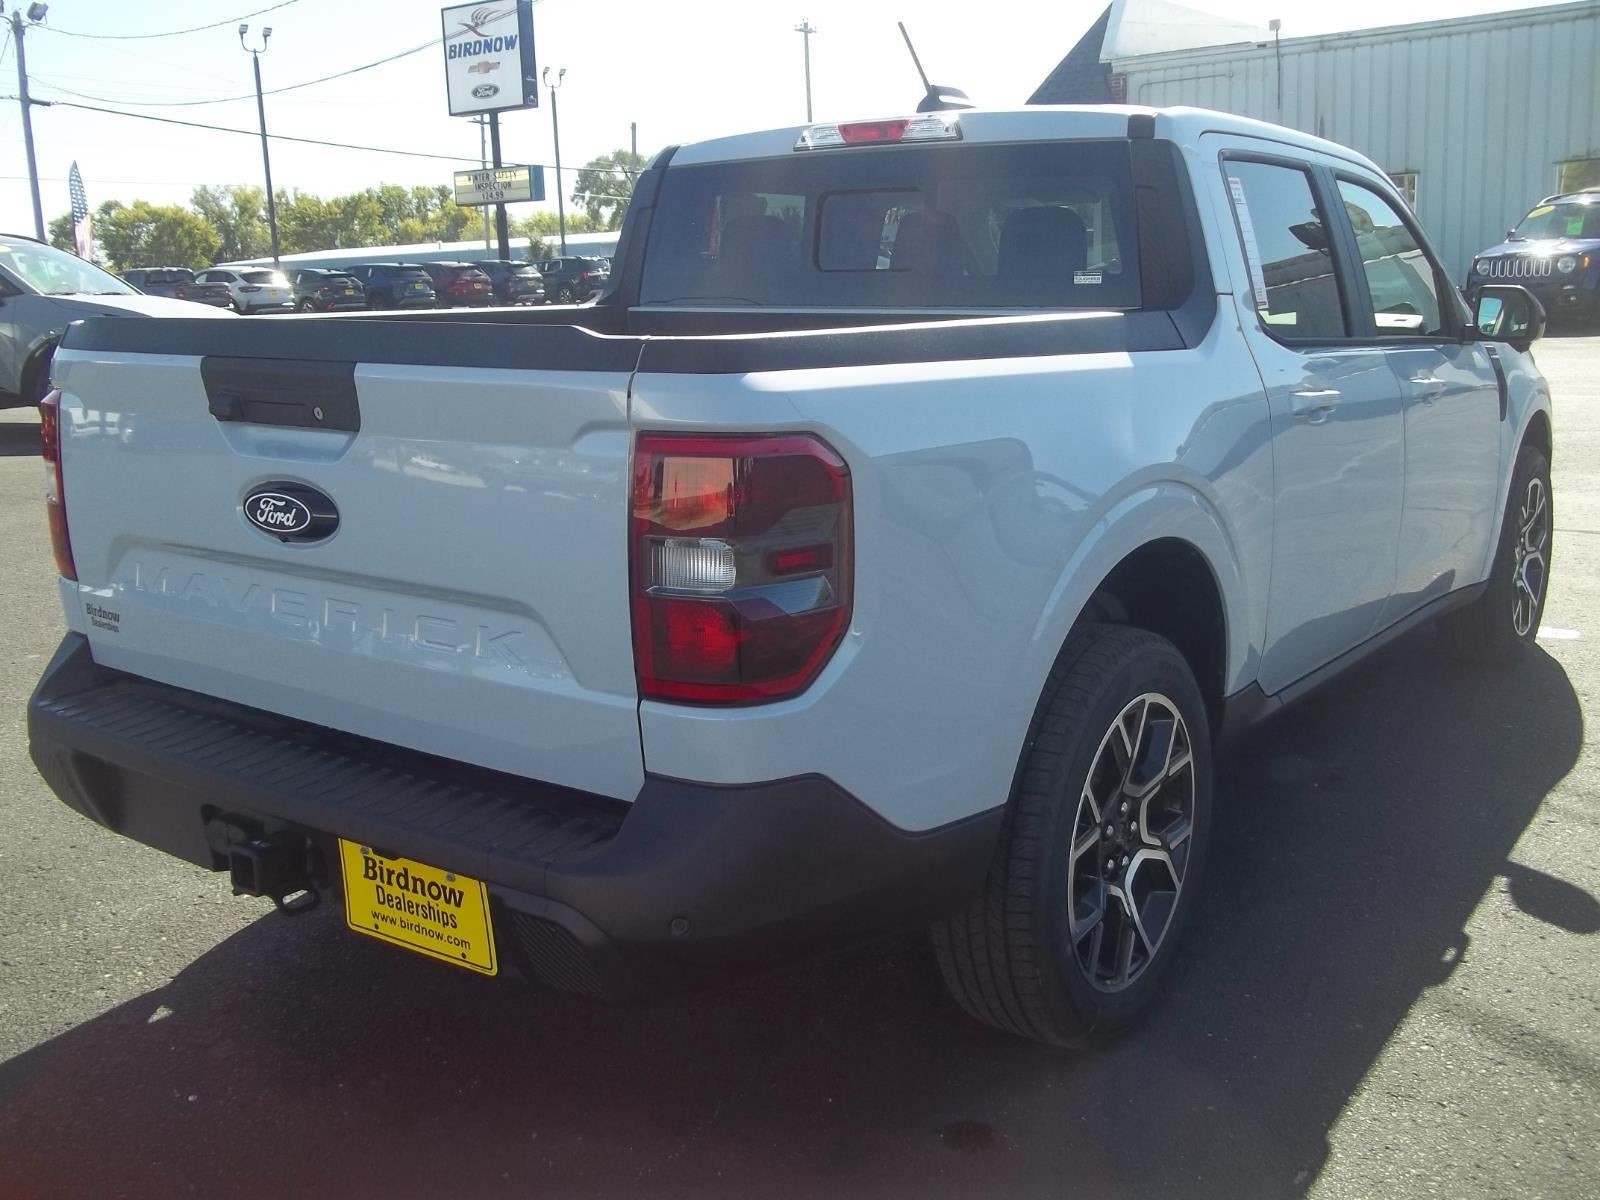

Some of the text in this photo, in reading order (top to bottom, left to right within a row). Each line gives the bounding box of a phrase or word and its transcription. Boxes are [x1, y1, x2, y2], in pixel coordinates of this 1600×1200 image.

[448, 34, 517, 59] BIRDNOW
[475, 181, 512, 191] INSPECTION
[494, 169, 517, 179] SAFETY
[257, 497, 296, 526] Ford
[86, 602, 120, 622] Birdnow
[135, 560, 525, 670] MAVERICK
[363, 856, 465, 908] Birdnow
[375, 884, 458, 929] Dealerships
[371, 909, 471, 950] www.birdnow.com
